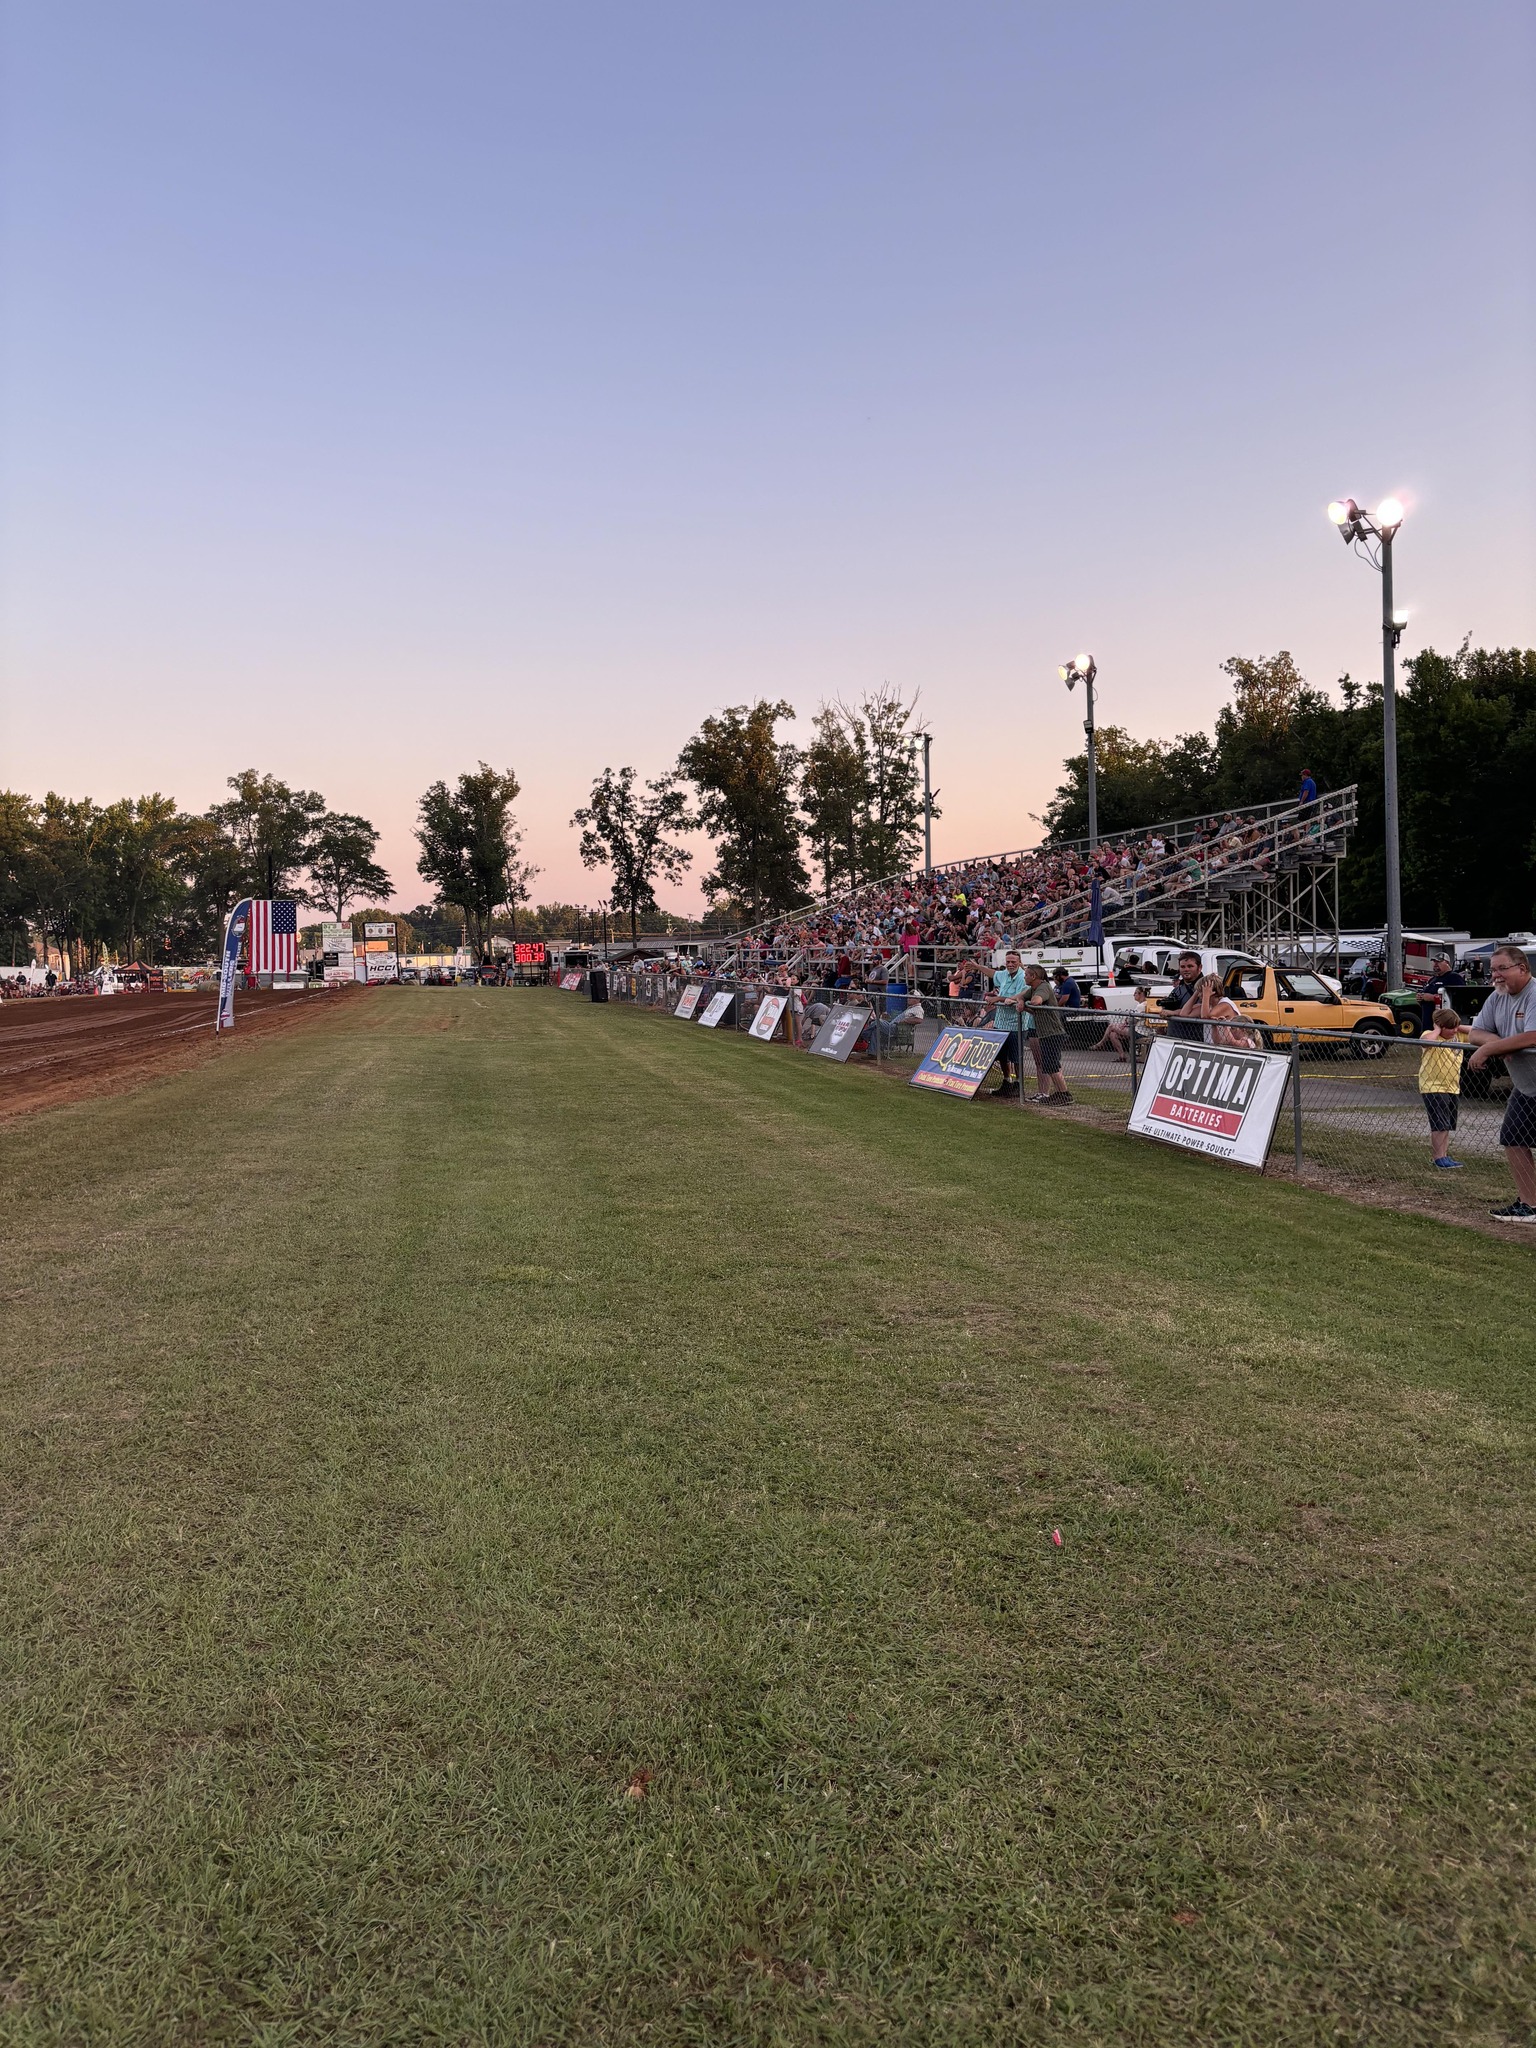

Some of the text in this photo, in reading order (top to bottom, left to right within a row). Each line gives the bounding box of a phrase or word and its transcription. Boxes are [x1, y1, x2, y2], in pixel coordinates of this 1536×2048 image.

[514, 942, 545, 953] 322.47
[515, 952, 545, 963] 300.39
[1165, 1055, 1254, 1105] OPTIMA
[1169, 1104, 1223, 1128] BATTERIES
[1141, 1124, 1153, 1133] THE
[1153, 1127, 1181, 1142] ULTIMATE
[1181, 1136, 1204, 1149] POWER
